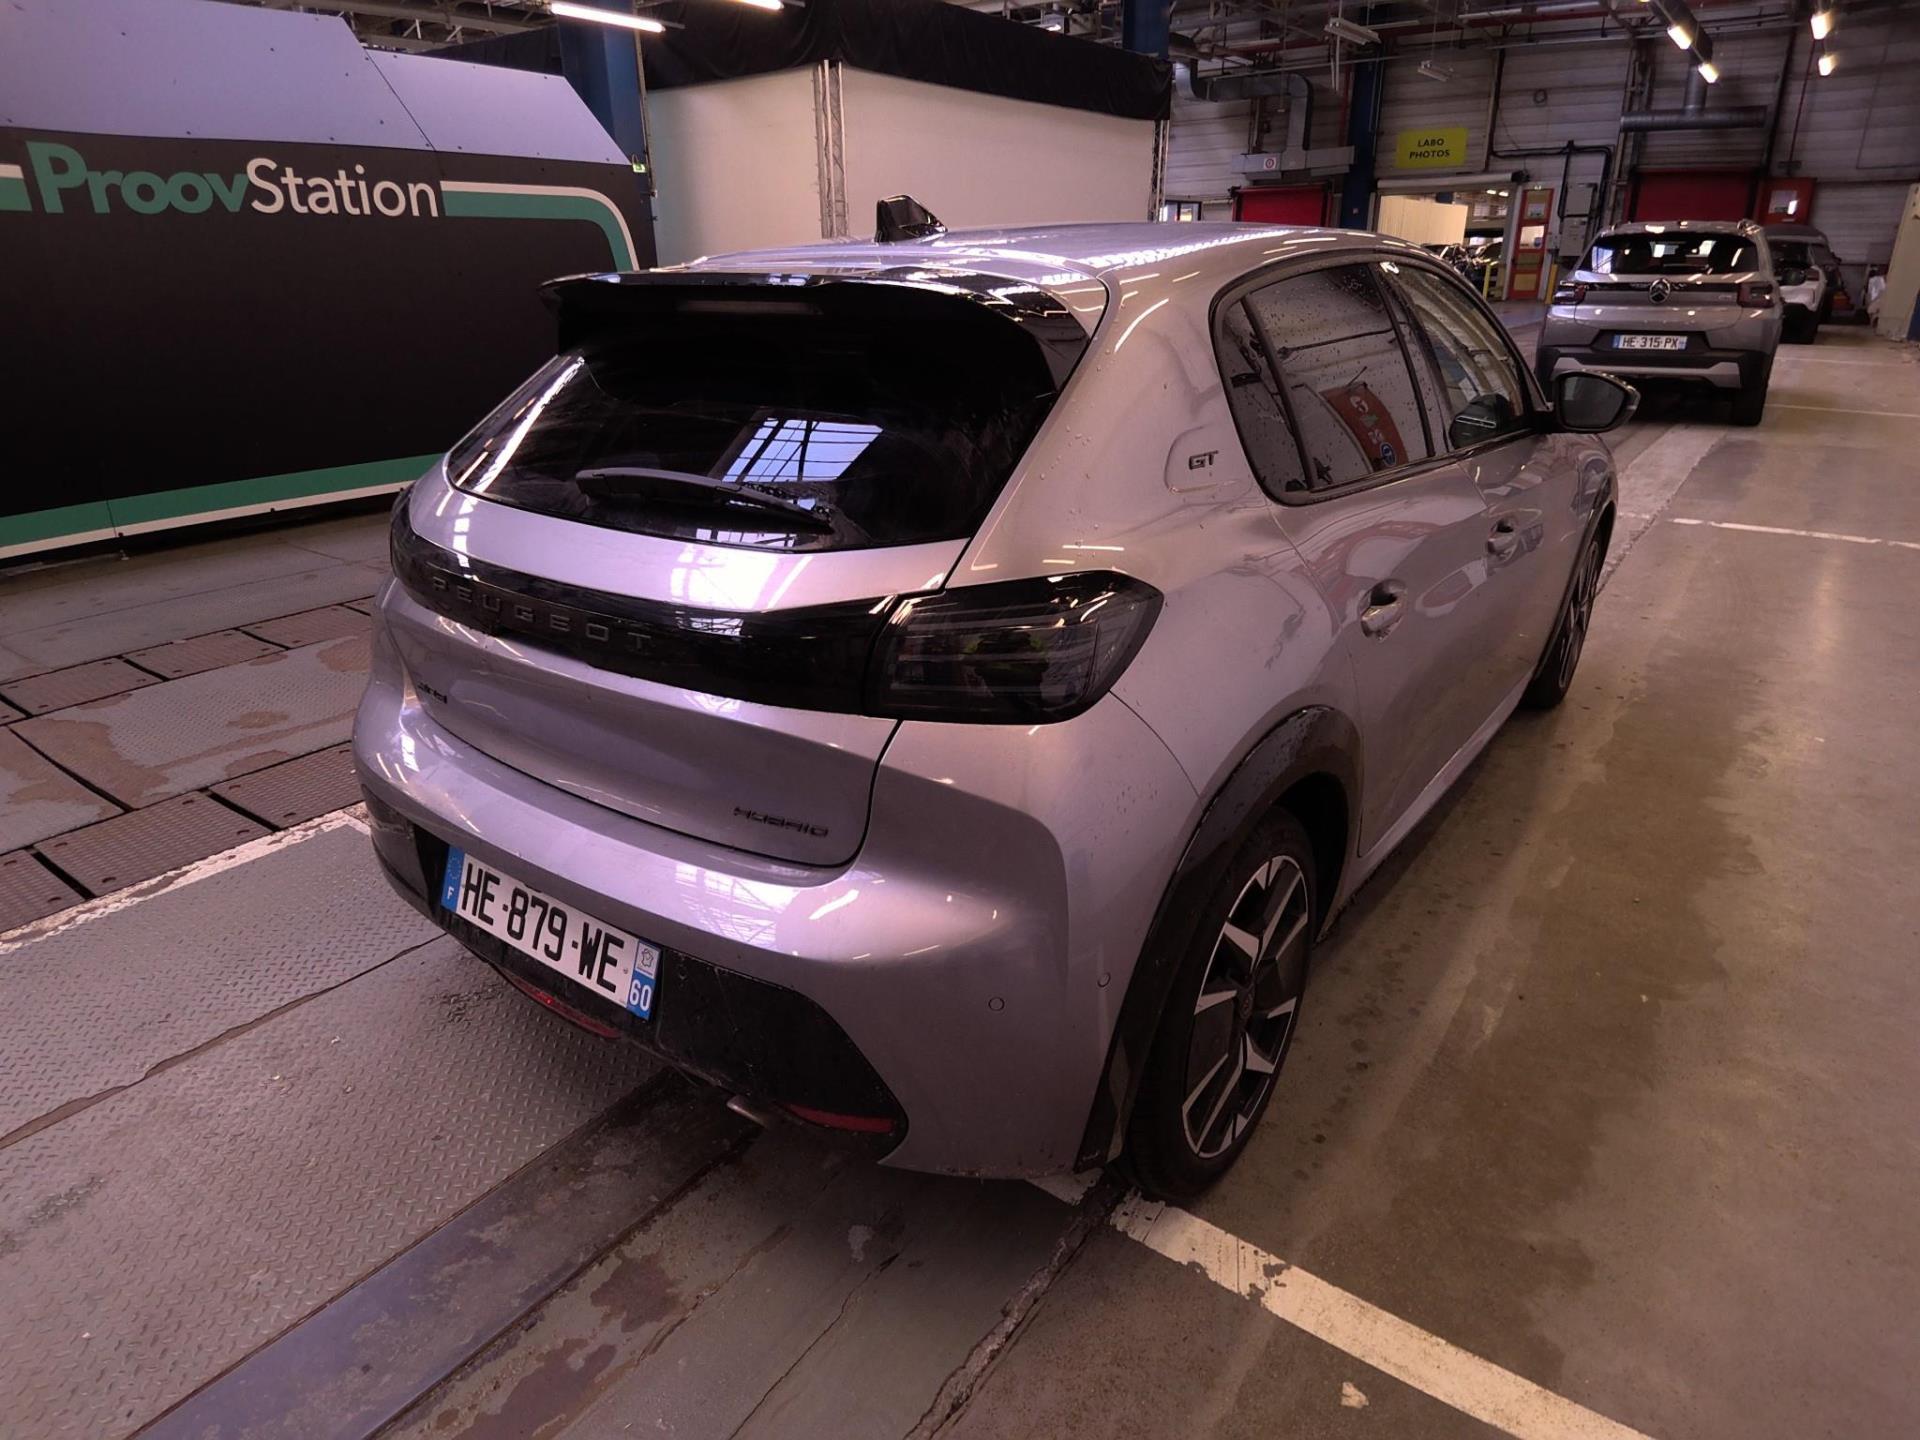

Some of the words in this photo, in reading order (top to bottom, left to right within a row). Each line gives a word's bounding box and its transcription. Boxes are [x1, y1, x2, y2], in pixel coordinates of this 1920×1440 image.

[1409, 149, 1451, 159] PHOTOS
[1417, 138, 1445, 148] LABO
[26, 140, 439, 217] ProovStation
[1189, 450, 1218, 470] GT
[432, 575, 652, 651] PEUGEOT
[733, 806, 829, 837] HYBRID
[446, 885, 456, 900] F
[629, 979, 652, 1011] 60
